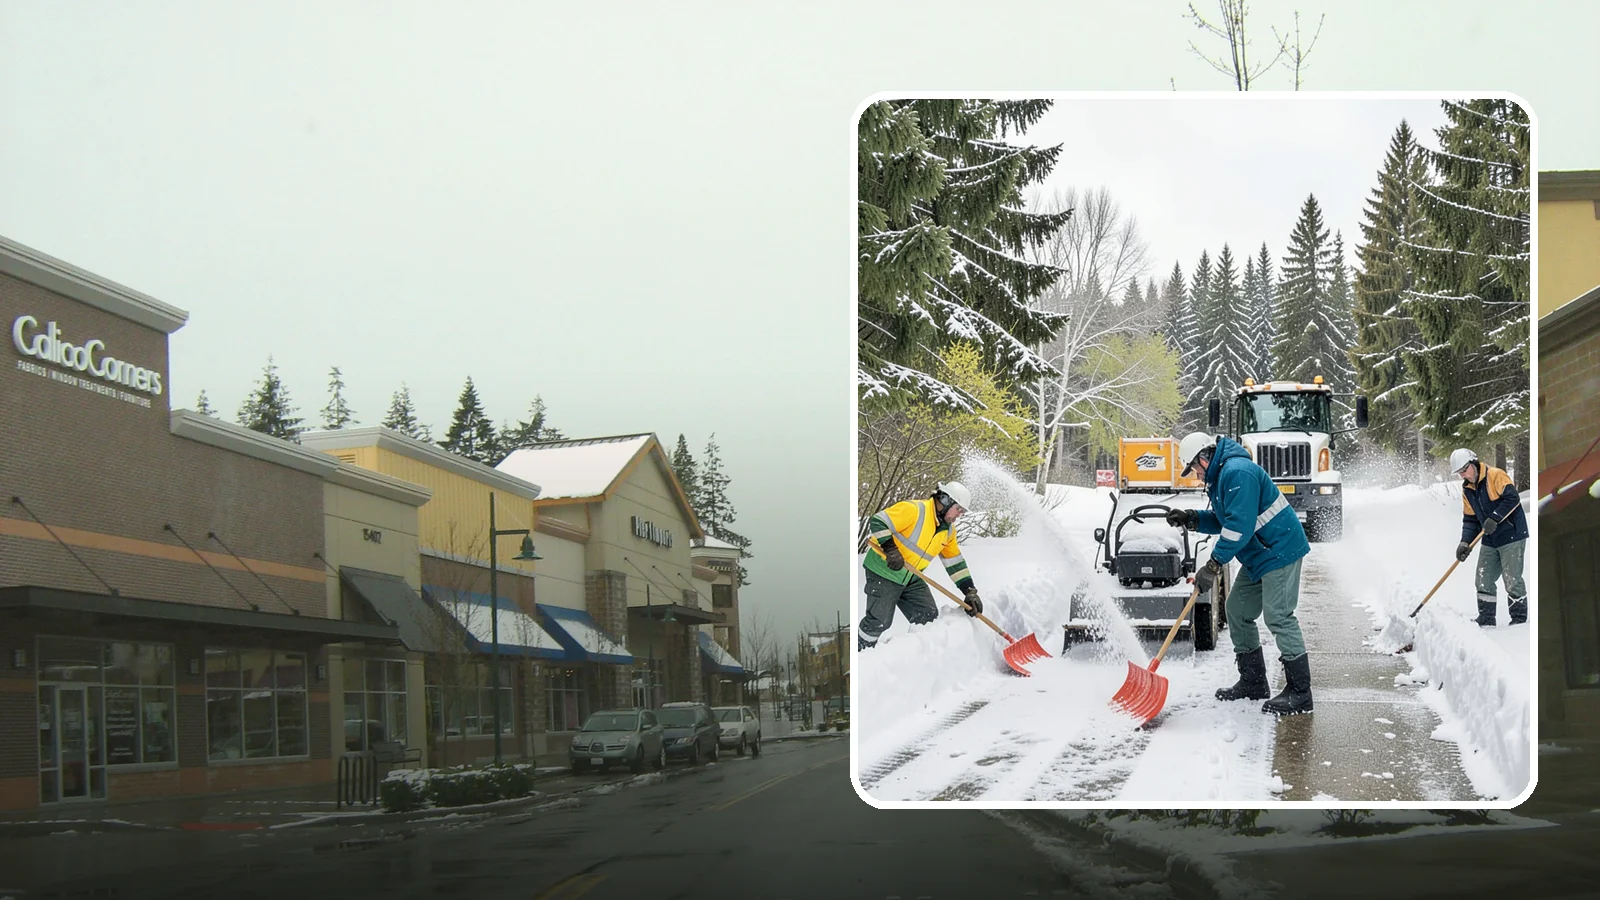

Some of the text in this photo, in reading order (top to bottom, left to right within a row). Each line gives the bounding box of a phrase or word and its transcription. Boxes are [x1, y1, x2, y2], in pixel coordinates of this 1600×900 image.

[17, 360, 47, 378] FABRICS
[51, 369, 78, 387] WINDOW
[78, 378, 117, 400] TREATMENTS
[120, 391, 152, 409] FURNITURE
